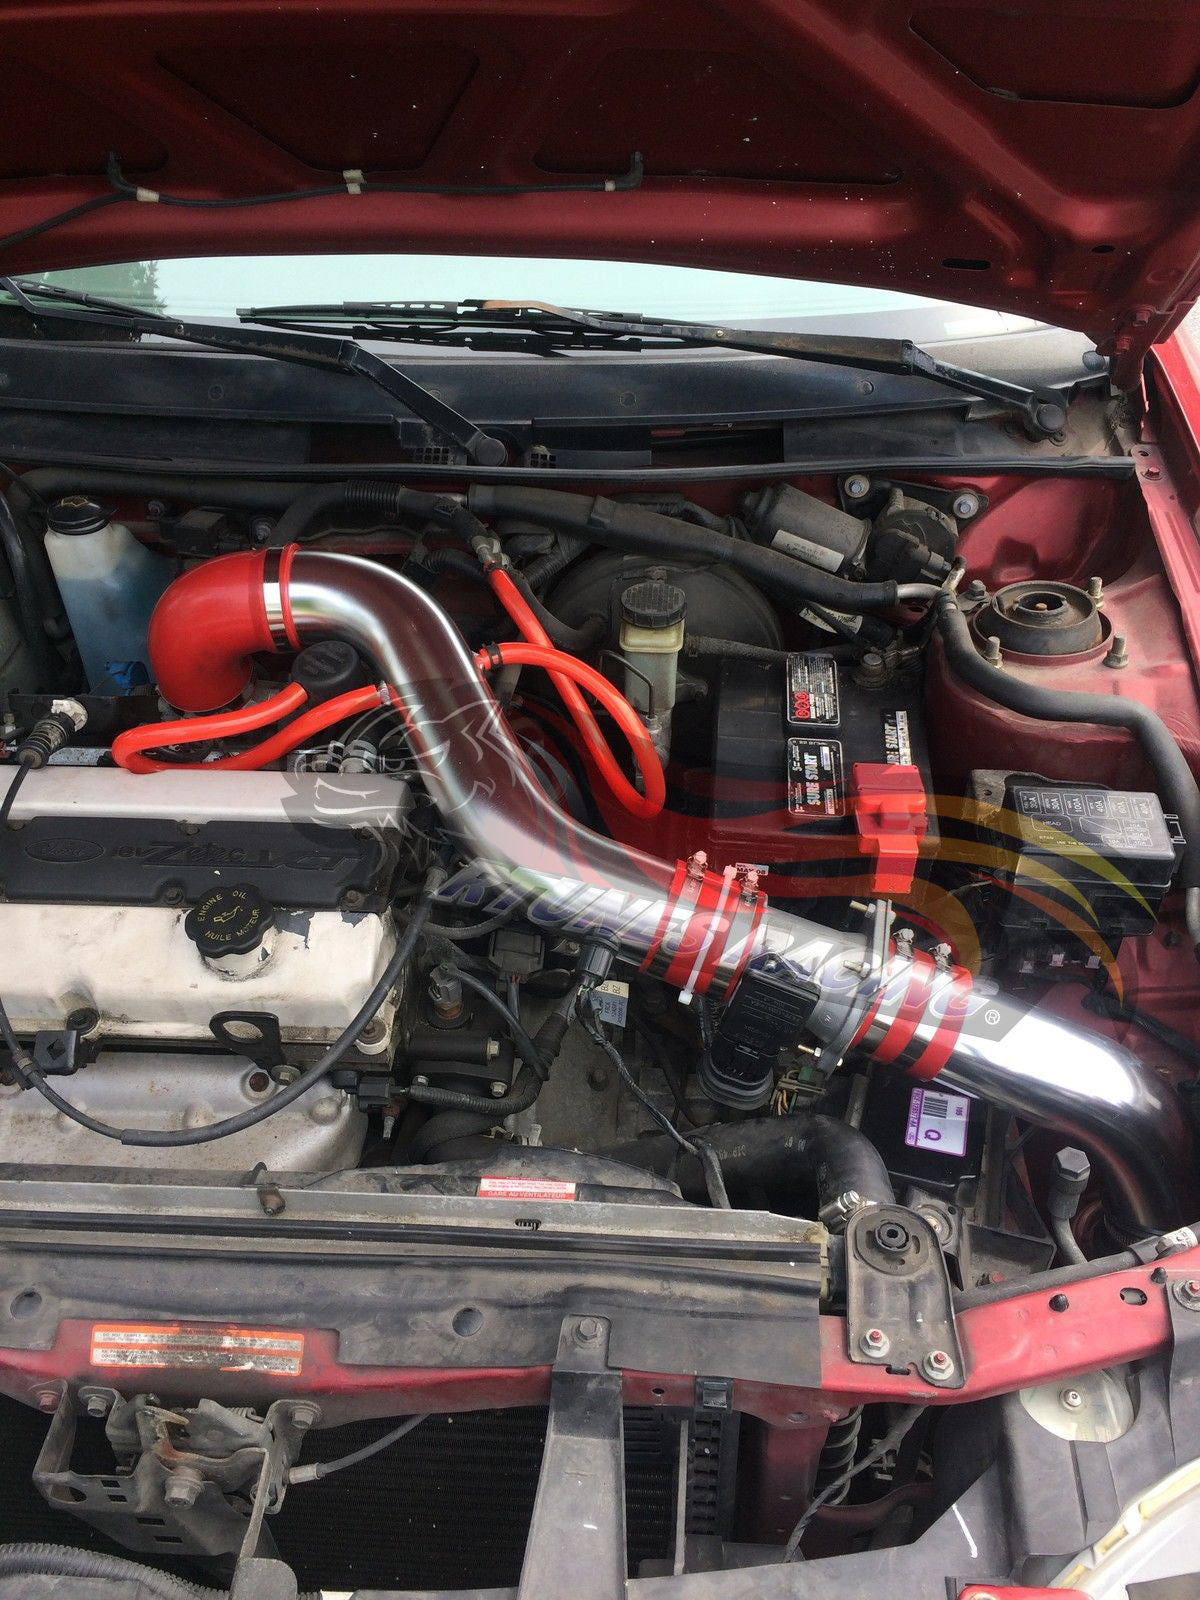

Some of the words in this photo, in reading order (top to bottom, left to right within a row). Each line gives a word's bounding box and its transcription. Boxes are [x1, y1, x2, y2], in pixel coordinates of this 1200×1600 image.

[803, 752, 819, 780] START
[805, 781, 821, 806] SURE
[197, 893, 224, 922] ENGINE
[232, 889, 249, 900] OIL
[204, 930, 233, 941] HUILE
[236, 908, 262, 937] MOTEUR
[924, 1129, 941, 1142] Q
